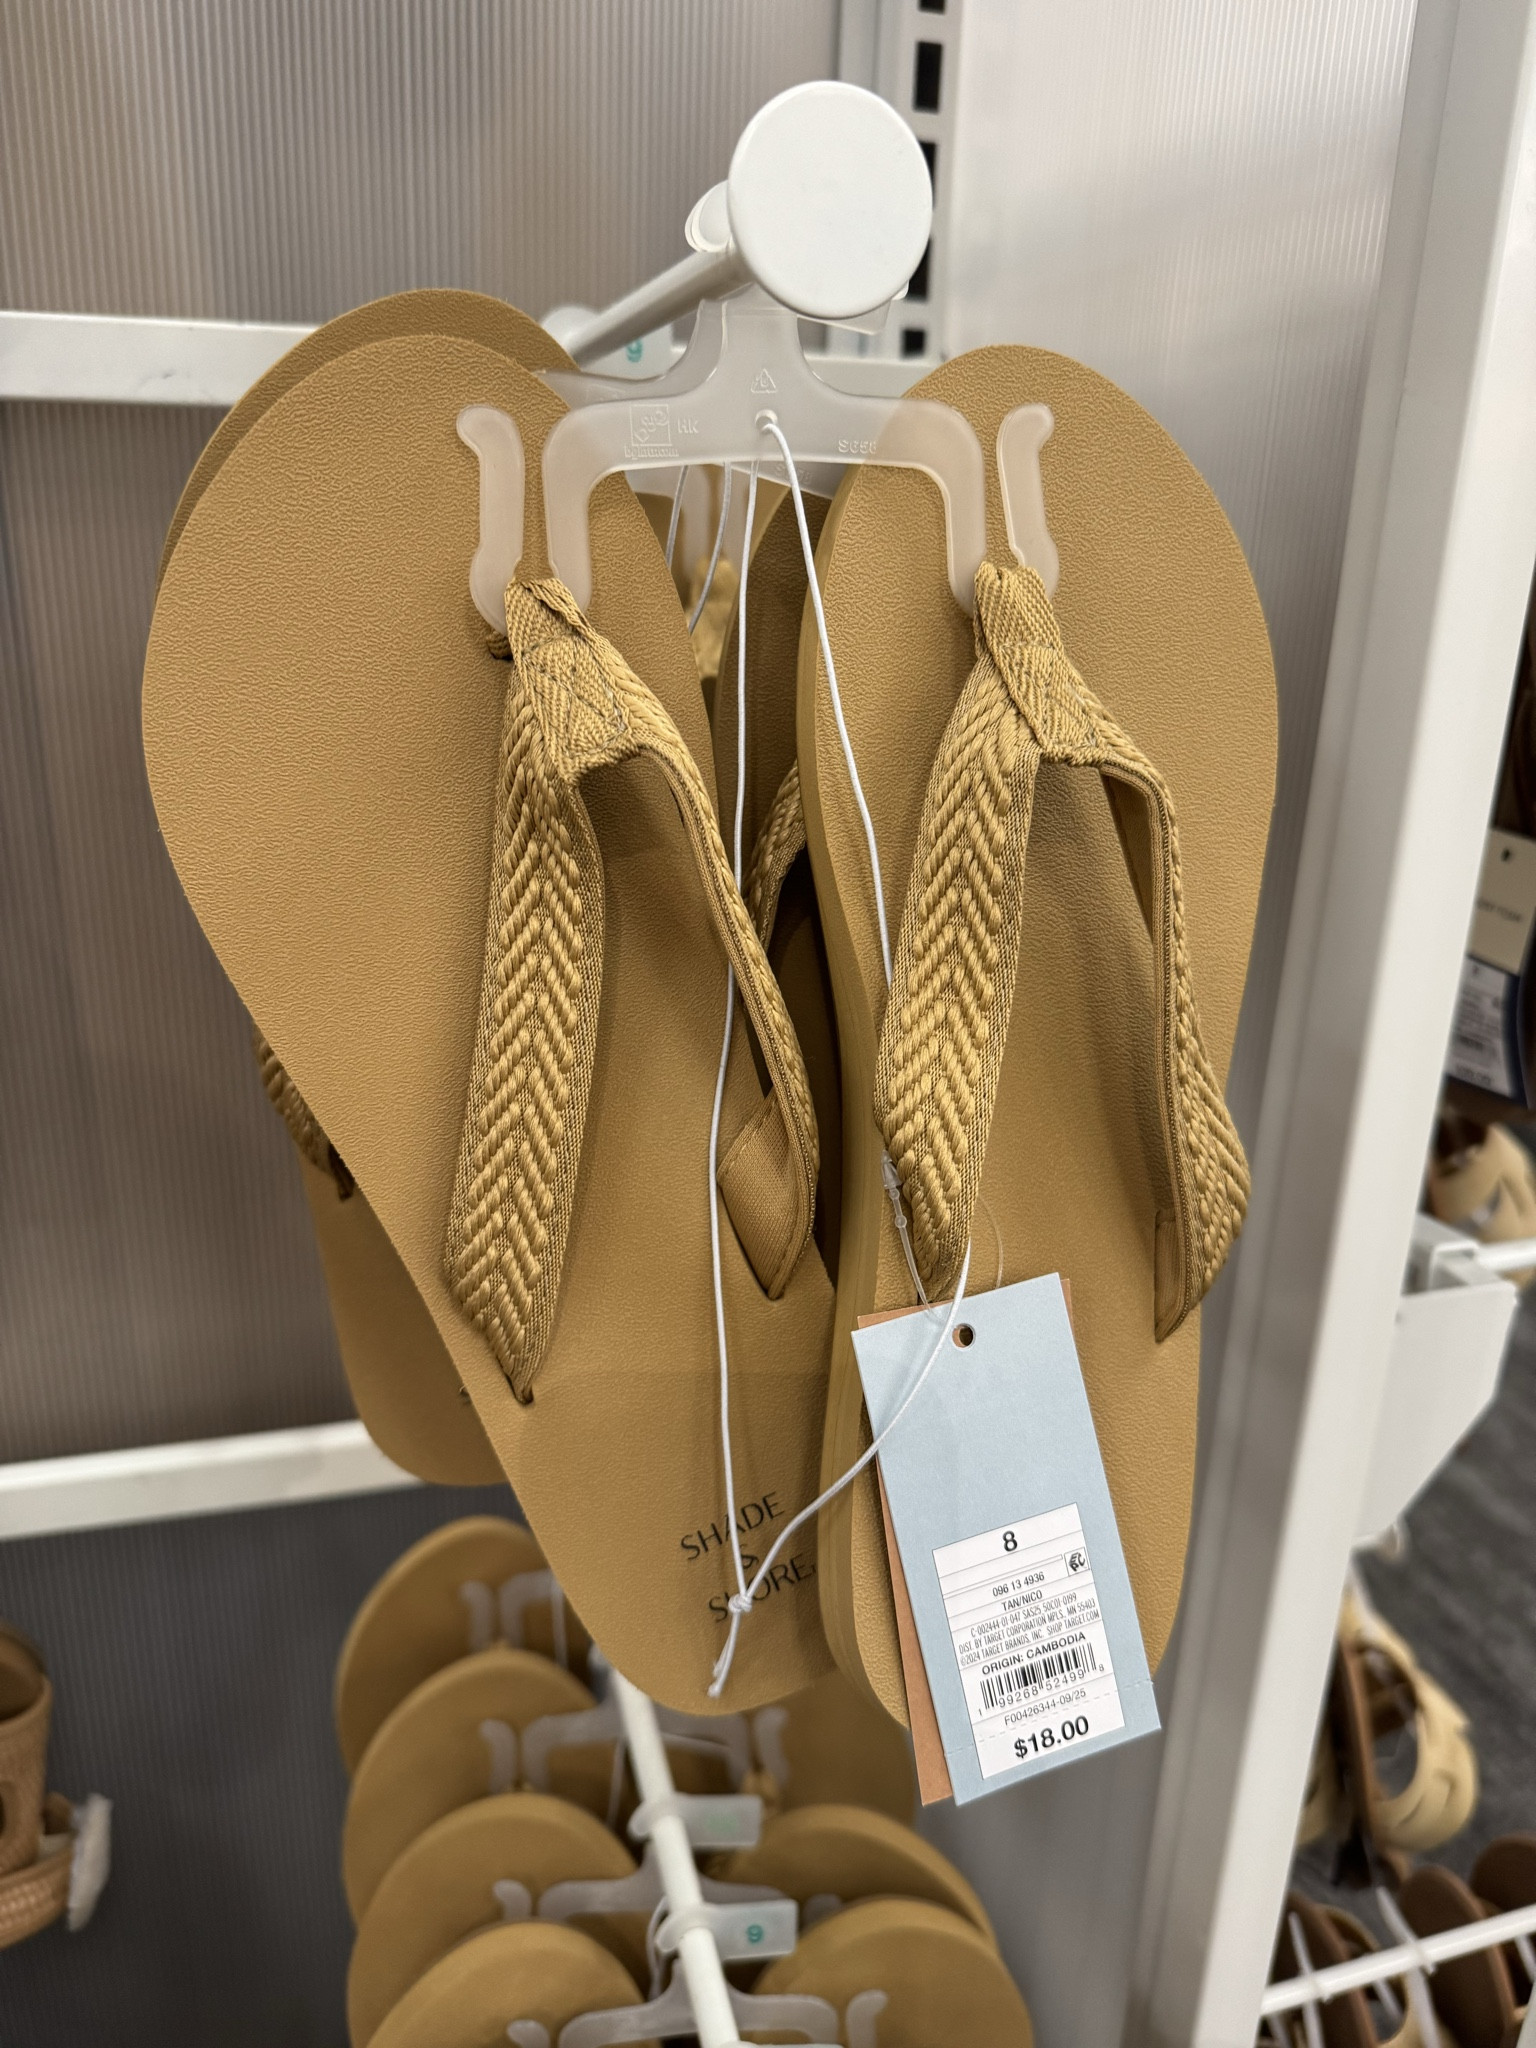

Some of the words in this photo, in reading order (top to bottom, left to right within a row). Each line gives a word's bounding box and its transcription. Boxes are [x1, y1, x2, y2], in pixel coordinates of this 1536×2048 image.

[1002, 1530, 1018, 1552] 8
[708, 1554, 815, 1623] SORE
[992, 1583, 1009, 1598] 096
[1011, 1580, 1022, 1592] 13
[1023, 1571, 1045, 1586] 4936
[1001, 1589, 1043, 1611] TAN/NICO
[974, 1637, 983, 1649] BY
[983, 1629, 1006, 1645] TARGET
[1006, 1614, 1047, 1638] CORPORATION
[1066, 1604, 1077, 1616] MN
[1077, 1598, 1096, 1613] 55403
[981, 1642, 1004, 1659] TARGET
[1047, 1621, 1063, 1636] SHOP
[1064, 1608, 1100, 1629] TARGET.COM
[981, 1653, 1024, 1676] ORIGIN:
[1026, 1631, 1087, 1659] CAMBODIA
[998, 1684, 1039, 1709] 99268
[1045, 1668, 1085, 1691] 52499
[1004, 1687, 1087, 1727] F00426344-09/25
[1013, 1715, 1090, 1759] $18.00
